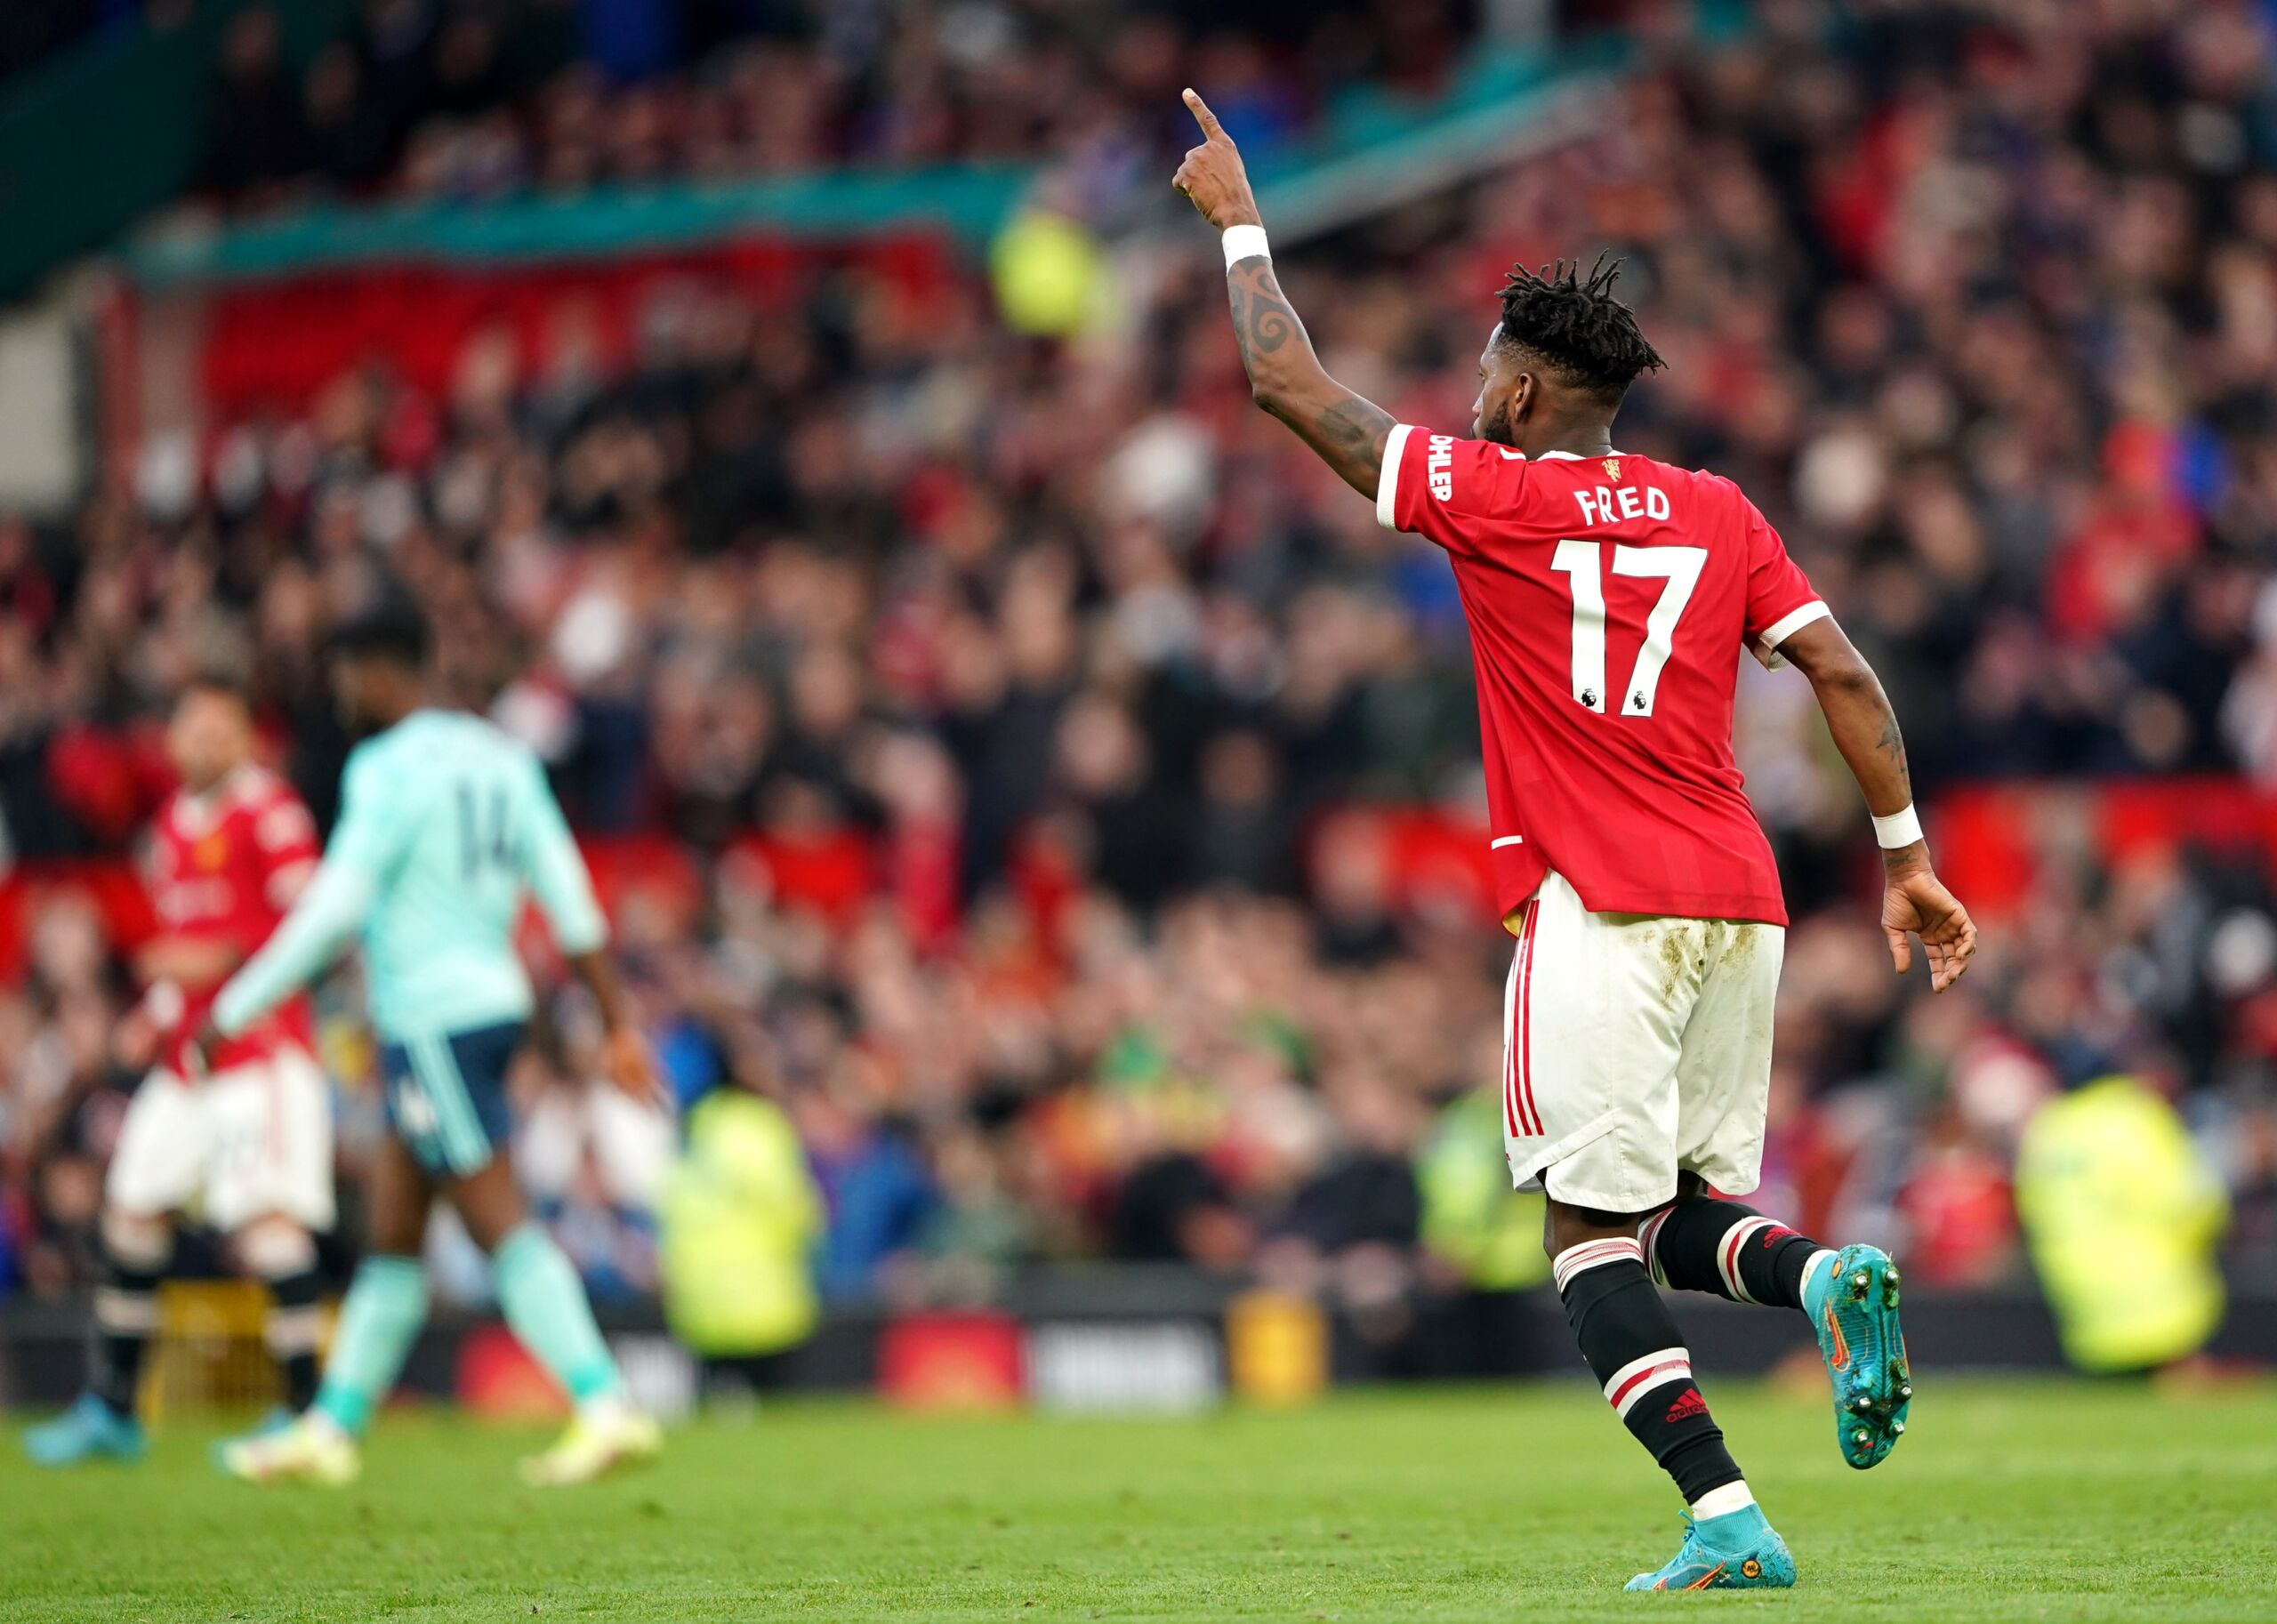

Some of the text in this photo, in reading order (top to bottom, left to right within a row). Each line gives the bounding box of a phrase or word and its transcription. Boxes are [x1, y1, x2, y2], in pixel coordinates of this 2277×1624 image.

[1428, 432, 1453, 502] OHLER
[1573, 486, 1670, 526] FRED
[1550, 539, 1709, 718] 17
[455, 774, 532, 882] 14
[1665, 1404, 1709, 1423] adida
